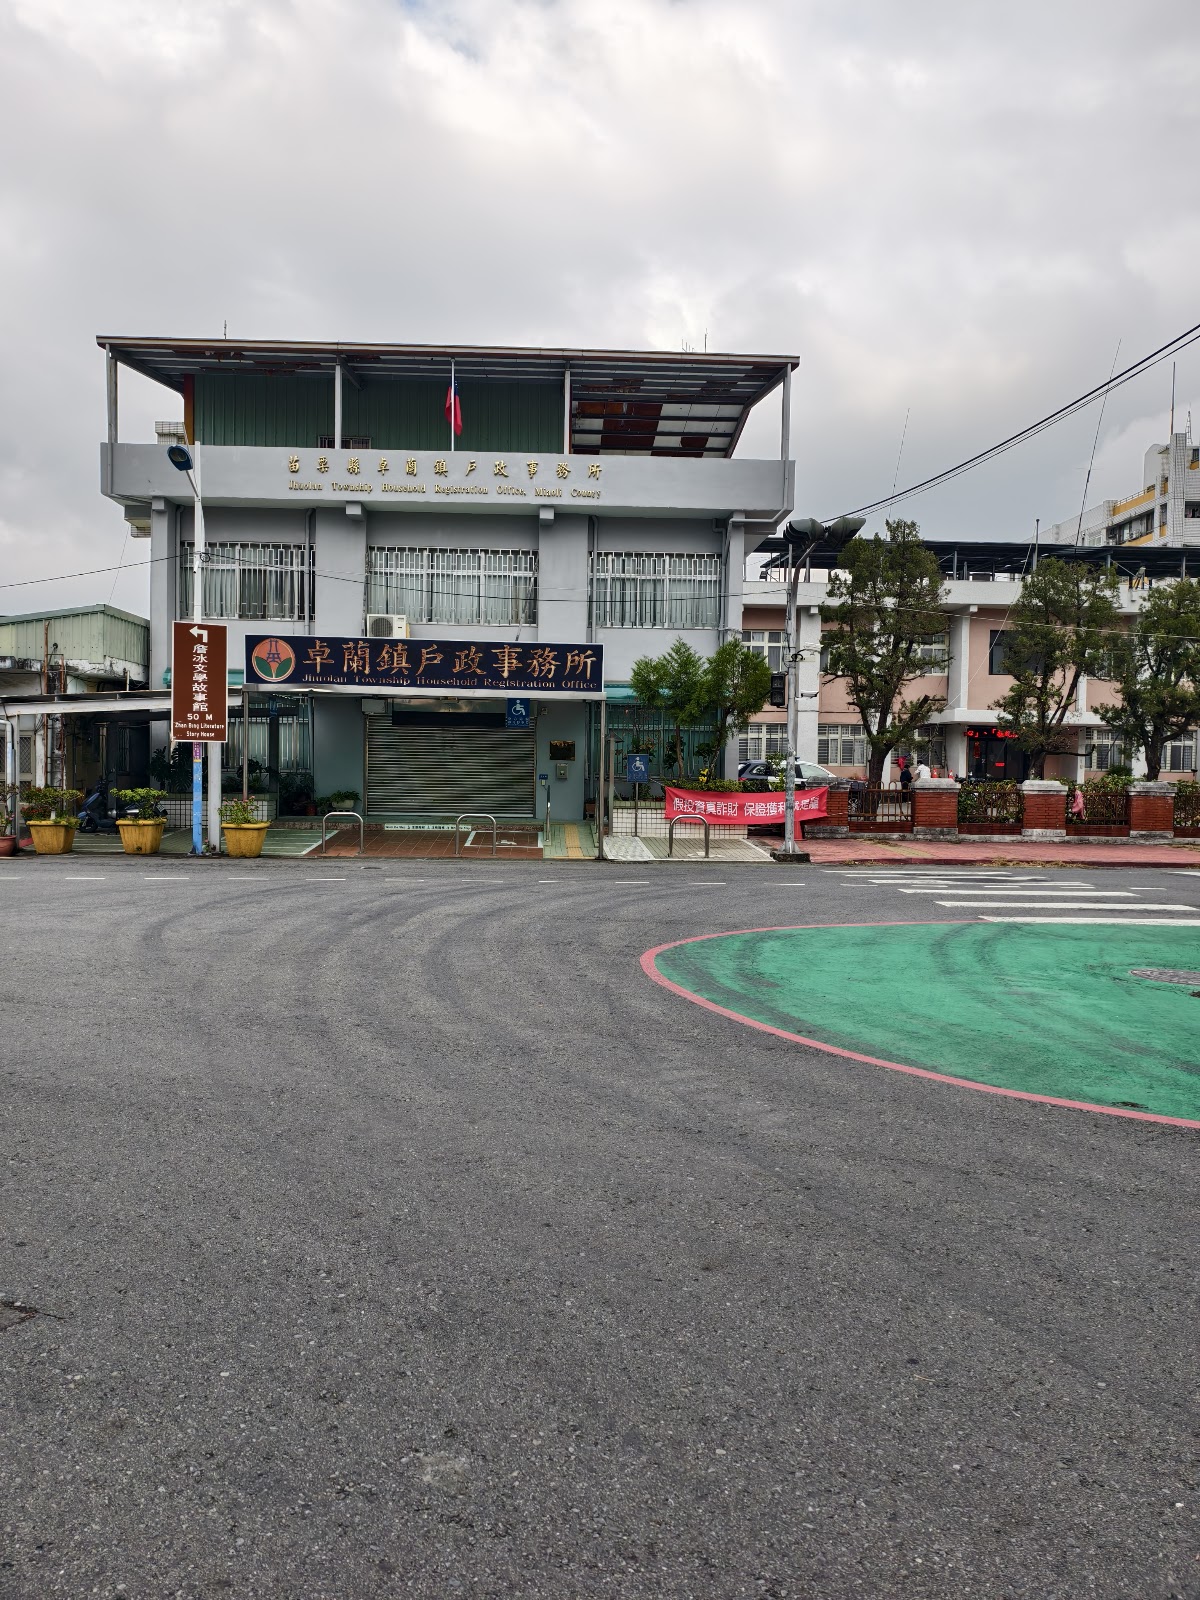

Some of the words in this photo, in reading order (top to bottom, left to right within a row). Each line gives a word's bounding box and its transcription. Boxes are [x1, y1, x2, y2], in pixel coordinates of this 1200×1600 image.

[288, 455, 602, 479] 苗栗縣卓蘭鎮戶政事務所
[331, 482, 373, 494] Township
[381, 483, 426, 493] Household
[435, 485, 488, 496] Registration
[496, 485, 526, 496] Office,
[534, 487, 562, 497] Miaoli
[303, 639, 597, 680] 卓蘭鎮戶政事務所
[192, 643, 208, 712] 詹冰文學故事館
[353, 675, 410, 686] Township
[416, 677, 477, 686] Household
[484, 678, 555, 688] Registration
[562, 680, 597, 689] Office
[187, 713, 199, 721] 50
[673, 797, 739, 817] 假投資真詐財
